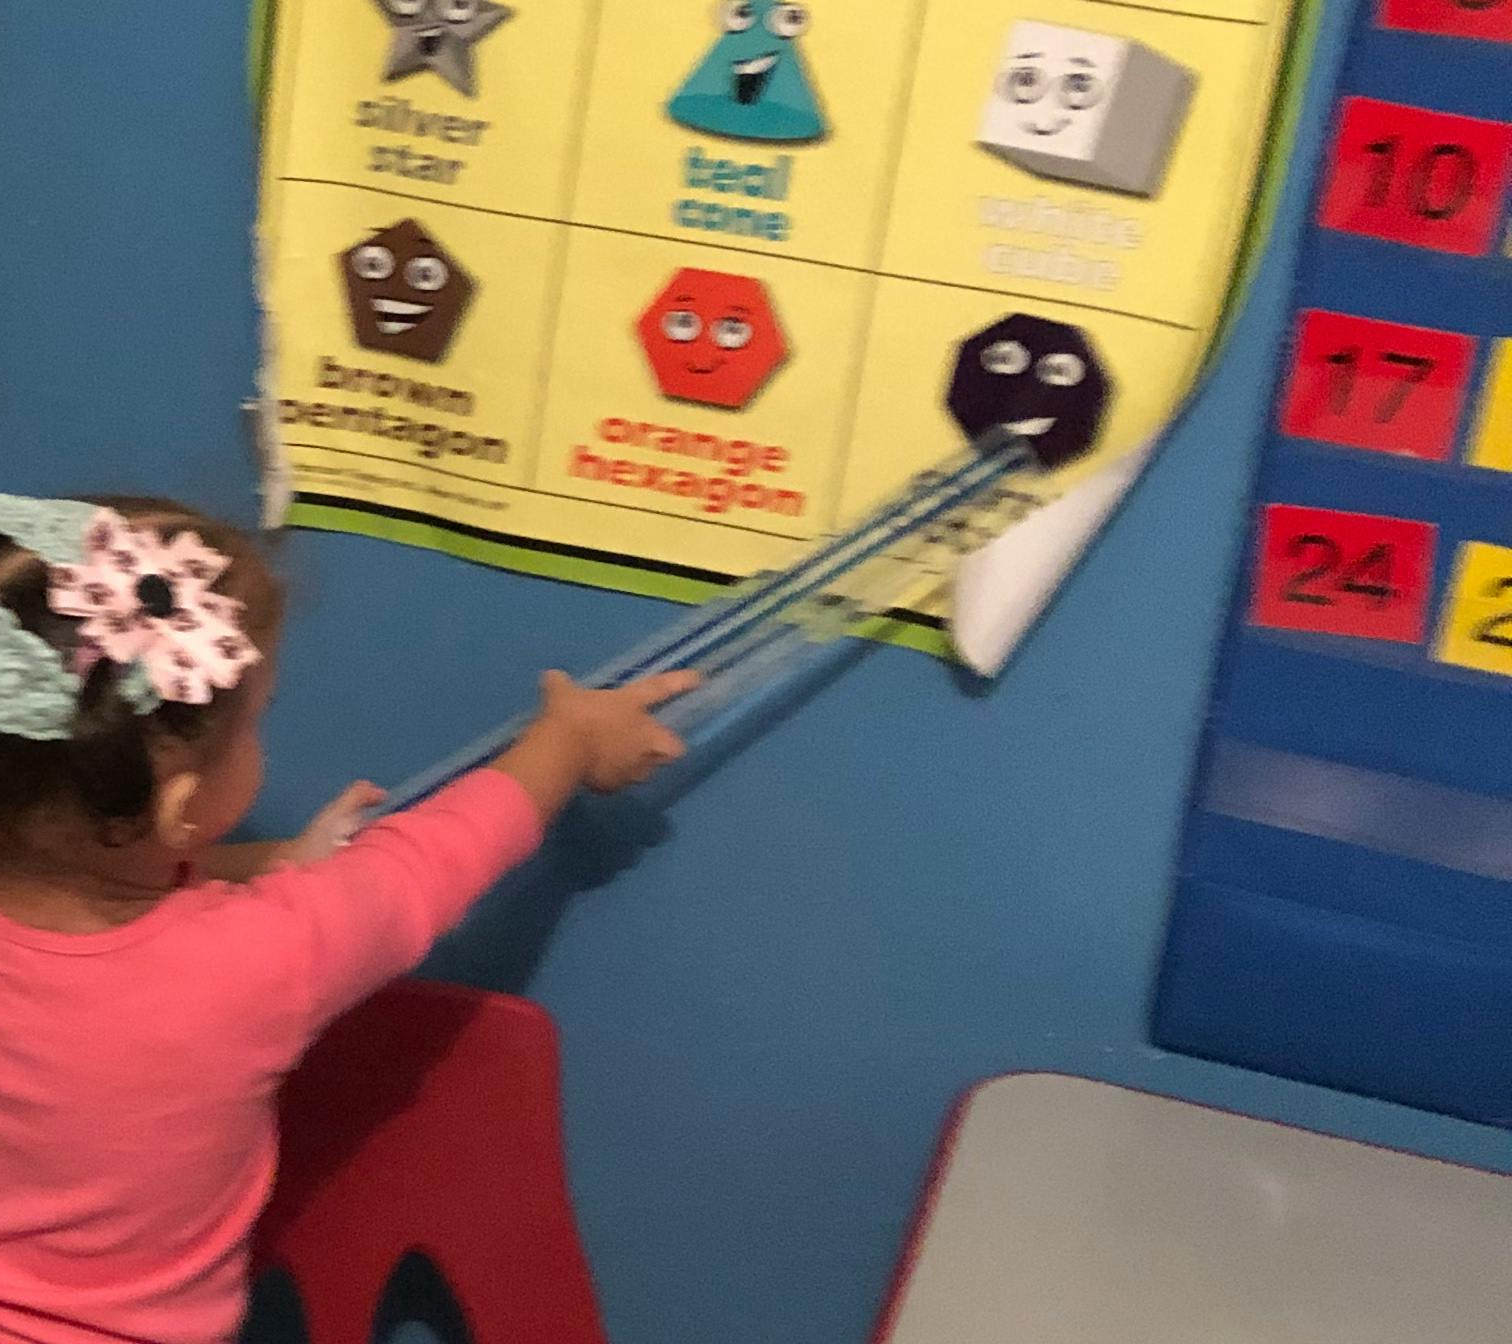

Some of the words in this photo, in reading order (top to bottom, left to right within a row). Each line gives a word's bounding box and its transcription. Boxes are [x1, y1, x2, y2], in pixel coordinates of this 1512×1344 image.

[352, 95, 492, 147] silver
[365, 144, 467, 186] star
[682, 145, 795, 201] teal
[1362, 134, 1481, 222] 10
[672, 198, 793, 242] cone
[315, 355, 478, 418] brown
[1324, 345, 1439, 425] 17
[596, 417, 794, 478] orange
[567, 444, 808, 518] hexagon
[1281, 532, 1401, 611] 24
